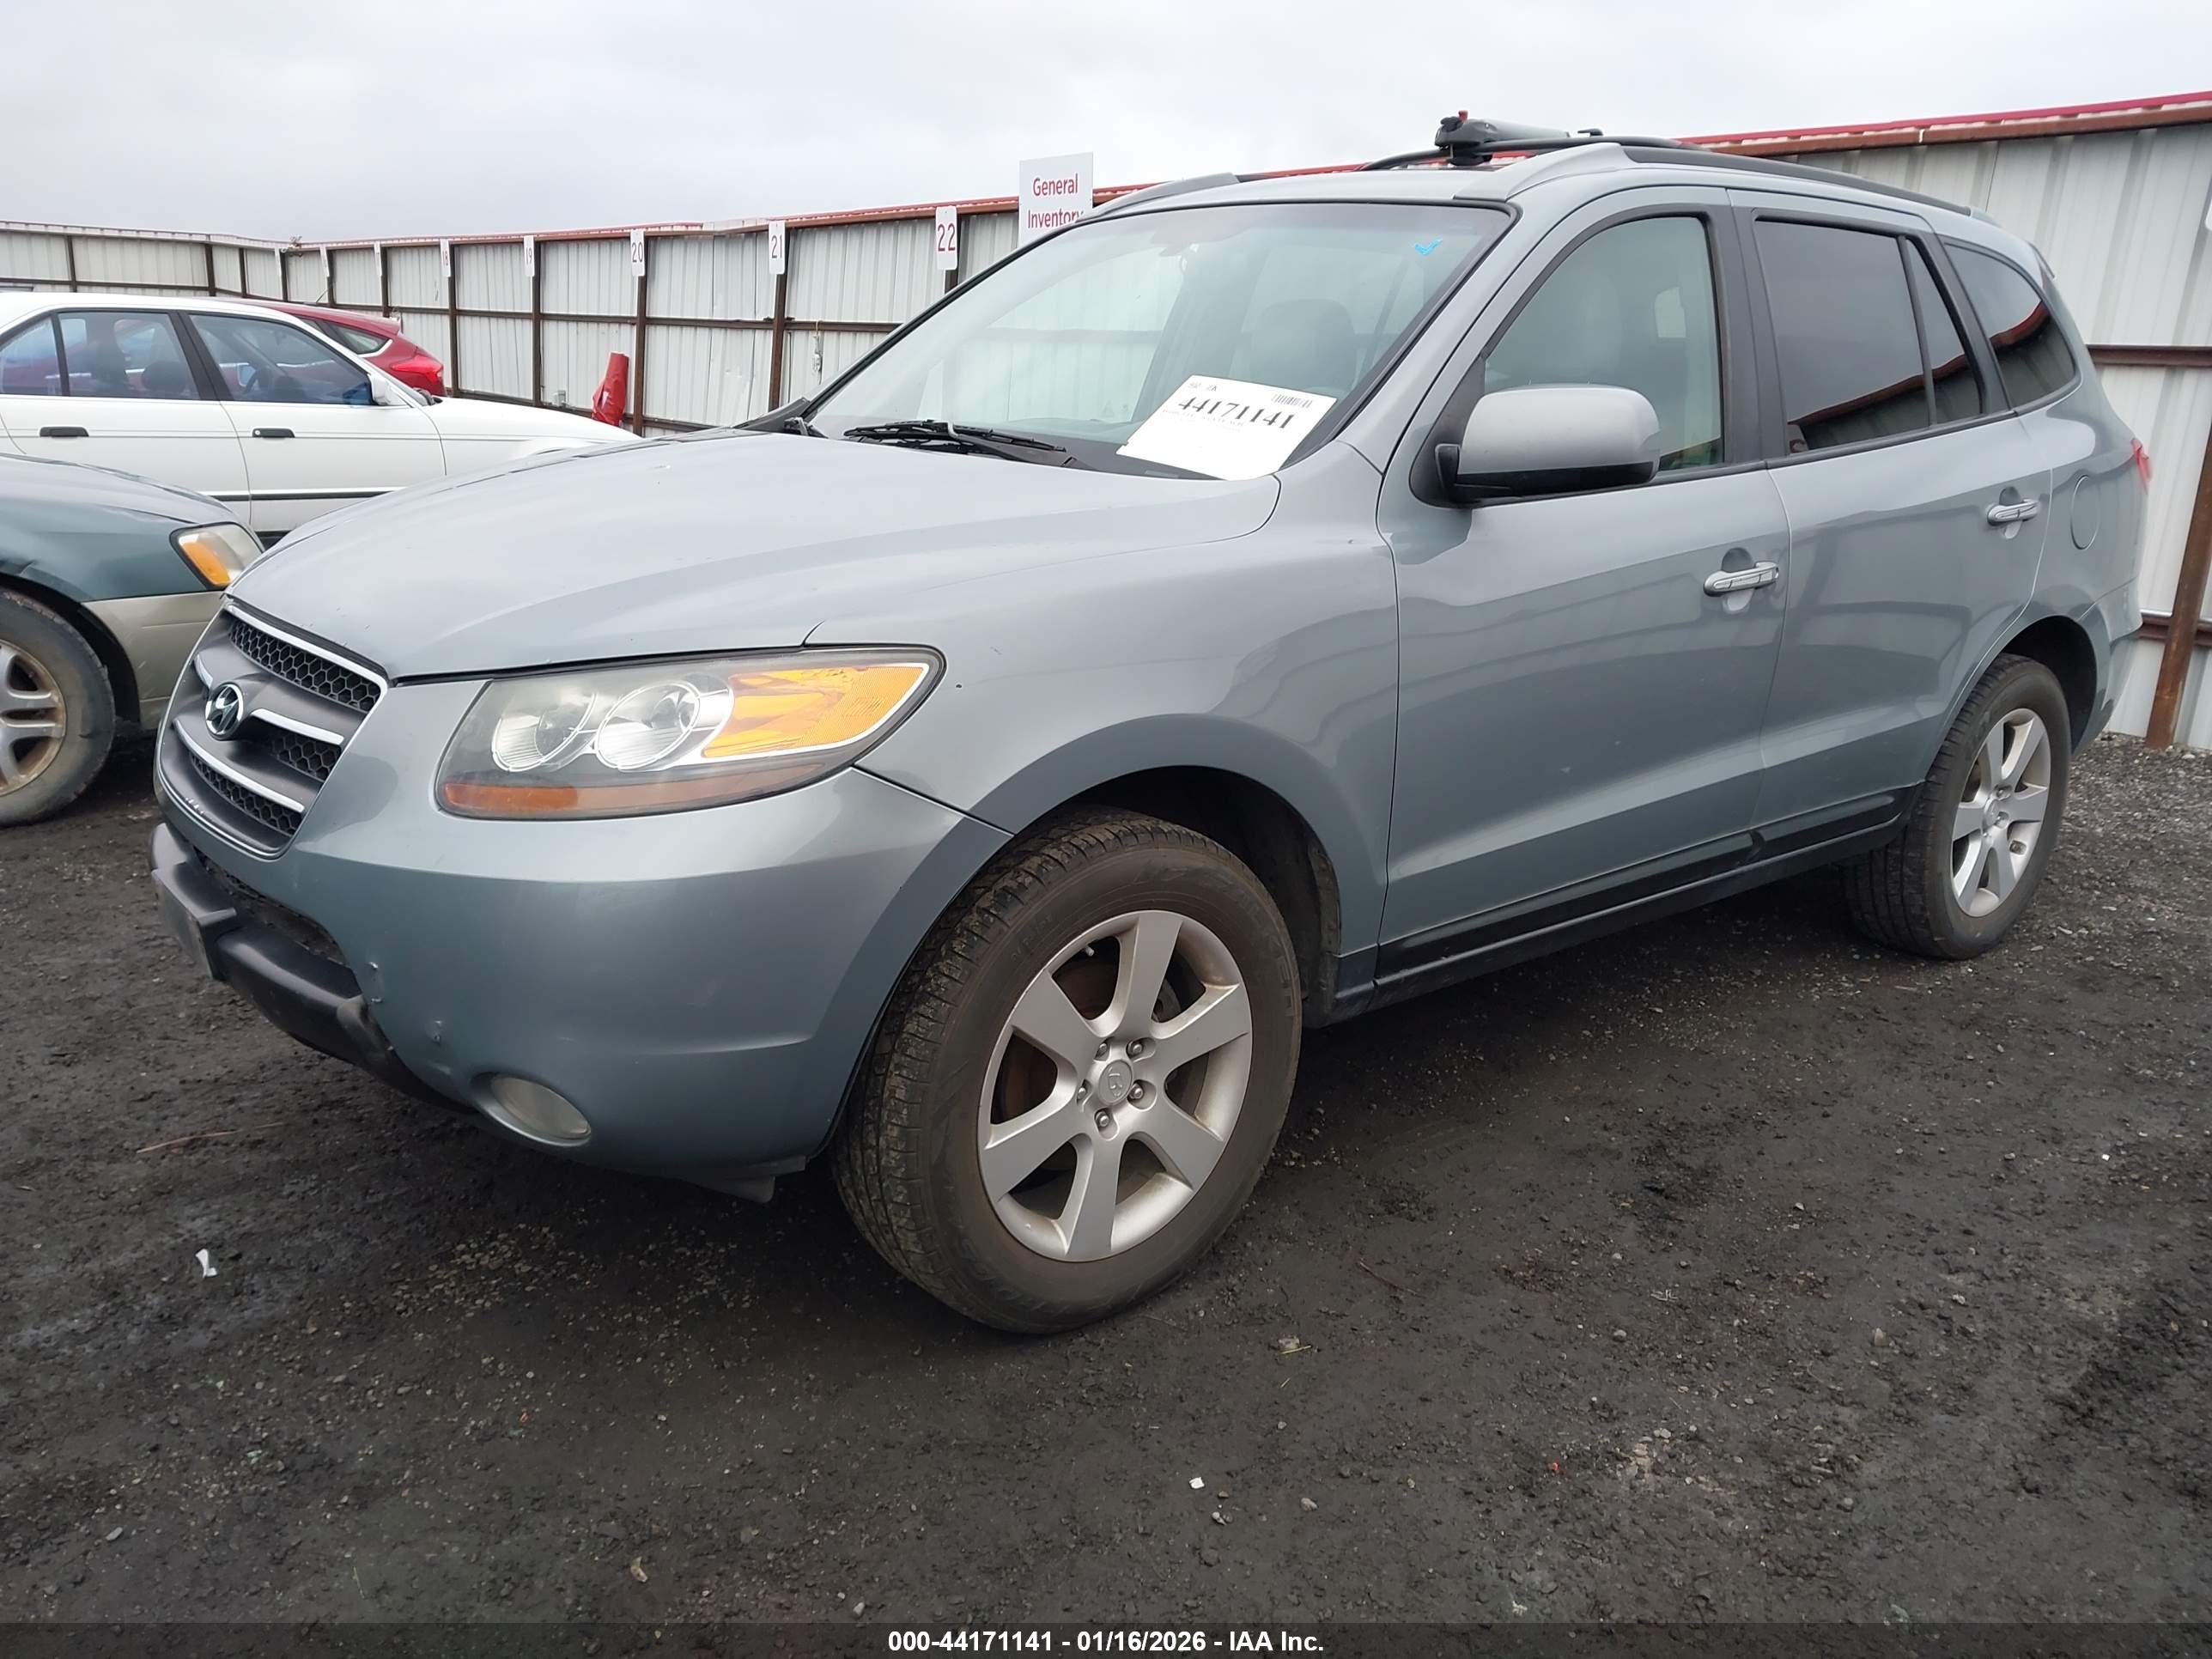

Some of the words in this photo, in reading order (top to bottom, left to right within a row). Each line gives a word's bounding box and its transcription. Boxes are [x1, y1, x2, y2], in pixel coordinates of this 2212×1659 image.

[1033, 173, 1079, 196] General
[771, 234, 782, 259] 21
[938, 223, 956, 252] 22
[526, 246, 532, 265] 19
[631, 241, 644, 263] 20
[1178, 397, 1295, 428] 44171141
